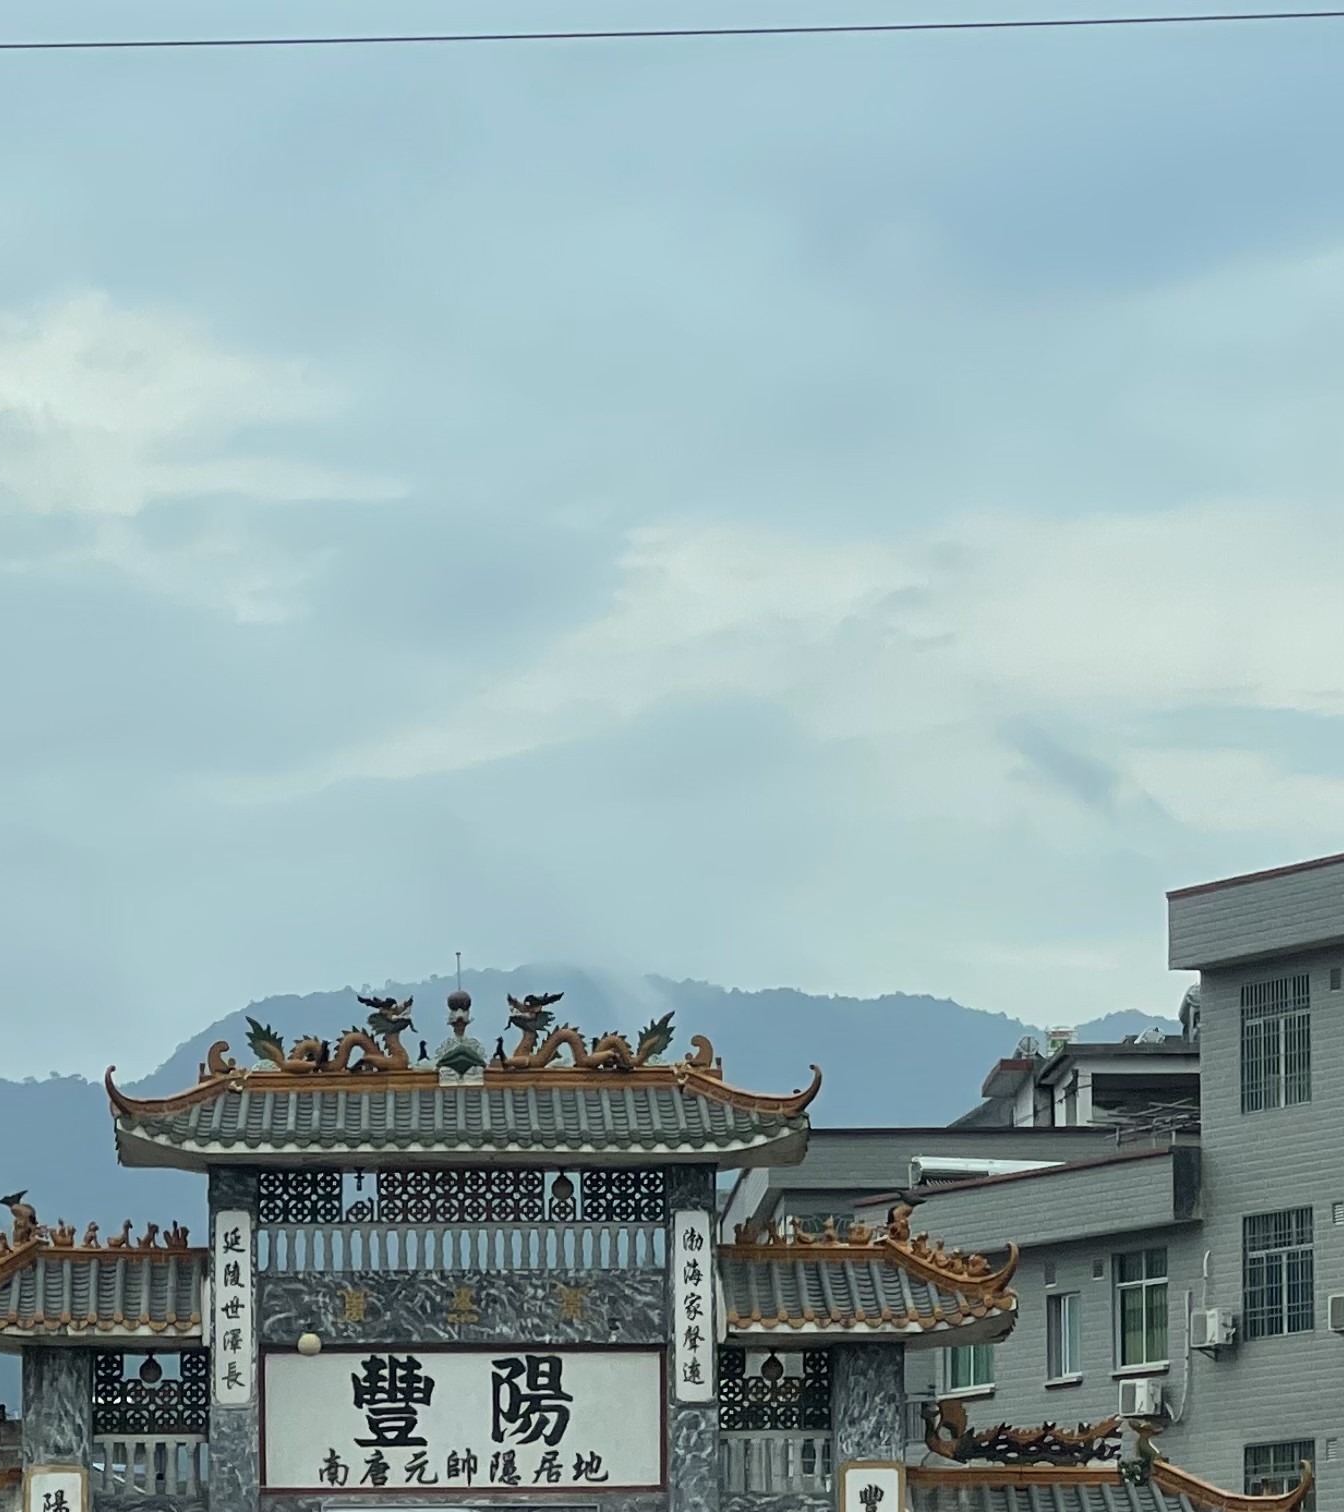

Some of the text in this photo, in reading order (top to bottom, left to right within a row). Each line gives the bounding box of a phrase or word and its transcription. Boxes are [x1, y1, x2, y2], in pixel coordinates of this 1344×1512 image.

[682, 1226, 705, 1386] 渤海家聲遠
[351, 1354, 574, 1448] 豐陽
[318, 1447, 609, 1487] 南唐元帥隱居地
